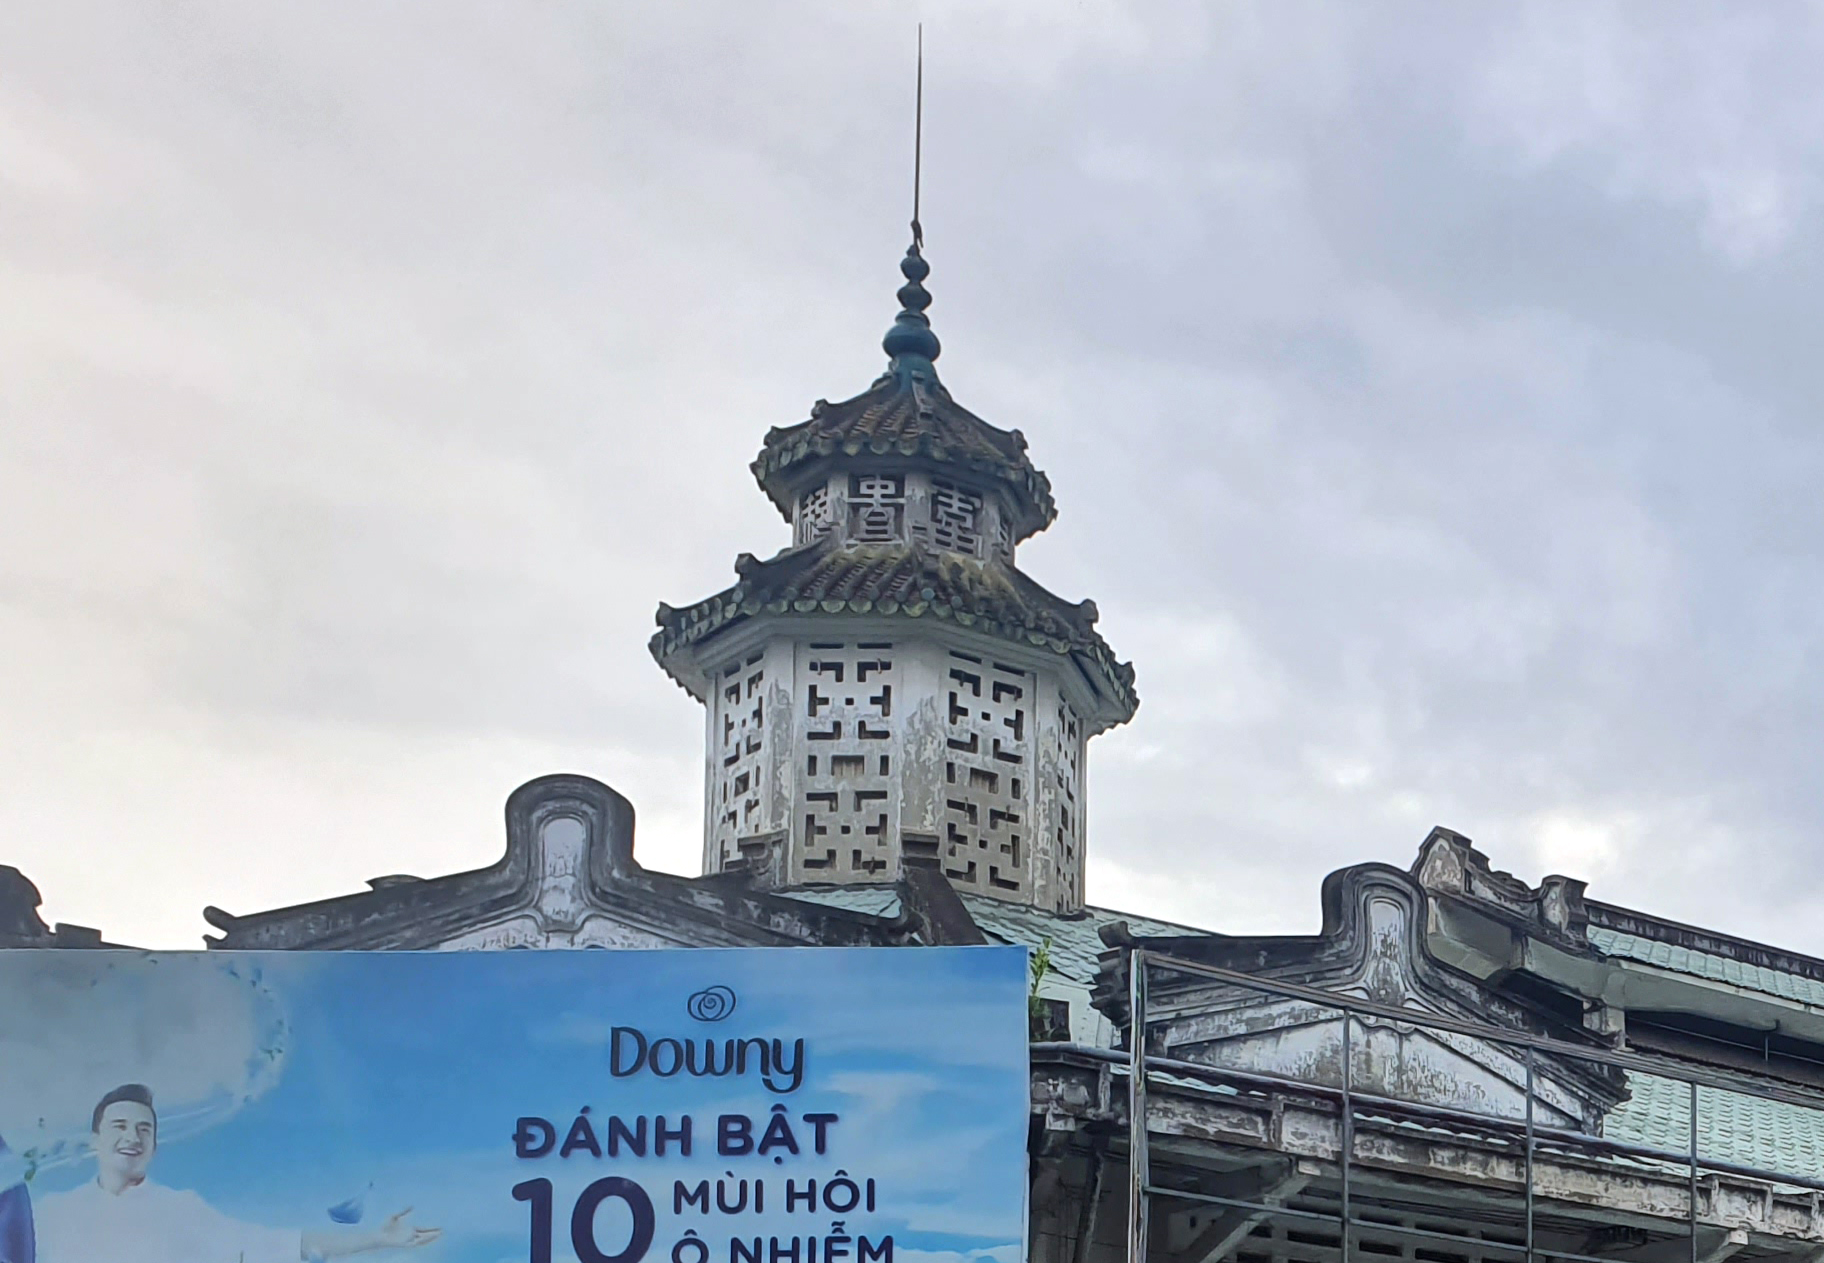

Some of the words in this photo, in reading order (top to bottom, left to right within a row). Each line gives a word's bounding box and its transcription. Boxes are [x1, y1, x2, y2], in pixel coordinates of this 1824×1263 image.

[610, 1026, 804, 1093] Downy
[512, 1106, 692, 1158] ĐÁNH
[717, 1103, 838, 1164] BẬT
[673, 1171, 763, 1215] MÙI
[786, 1169, 875, 1214] HÔI
